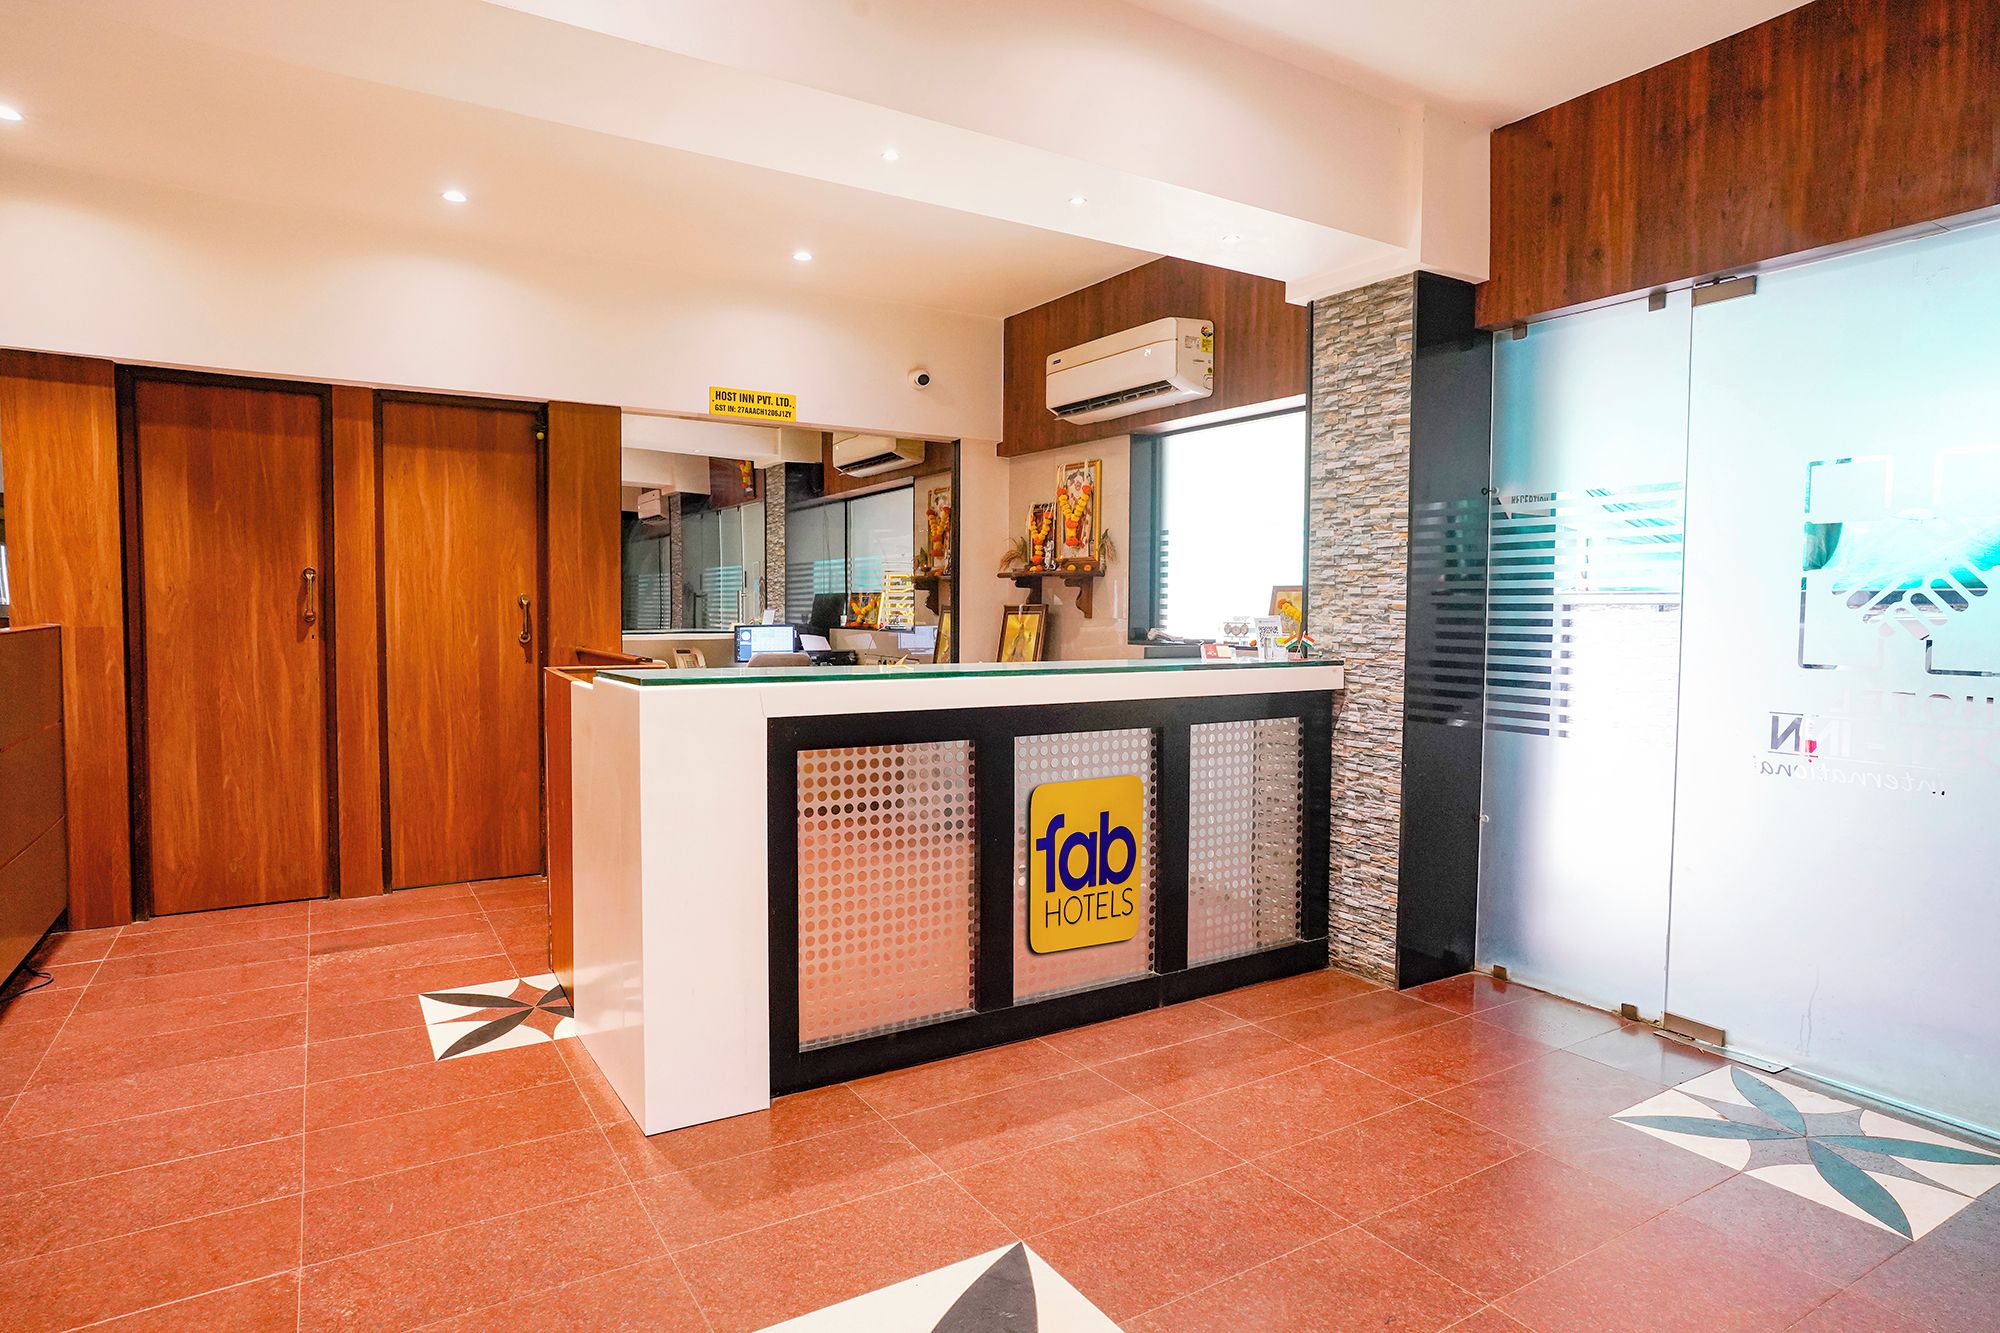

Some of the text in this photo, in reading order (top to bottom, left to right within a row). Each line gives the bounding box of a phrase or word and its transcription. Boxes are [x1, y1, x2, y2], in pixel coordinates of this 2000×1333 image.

[714, 403, 726, 412] GST
[728, 405, 737, 413] IN:
[715, 390, 792, 408] HOST INN PVT. LTD.
[1036, 811, 1137, 893] fab
[1045, 887, 1134, 929] HOTELS
